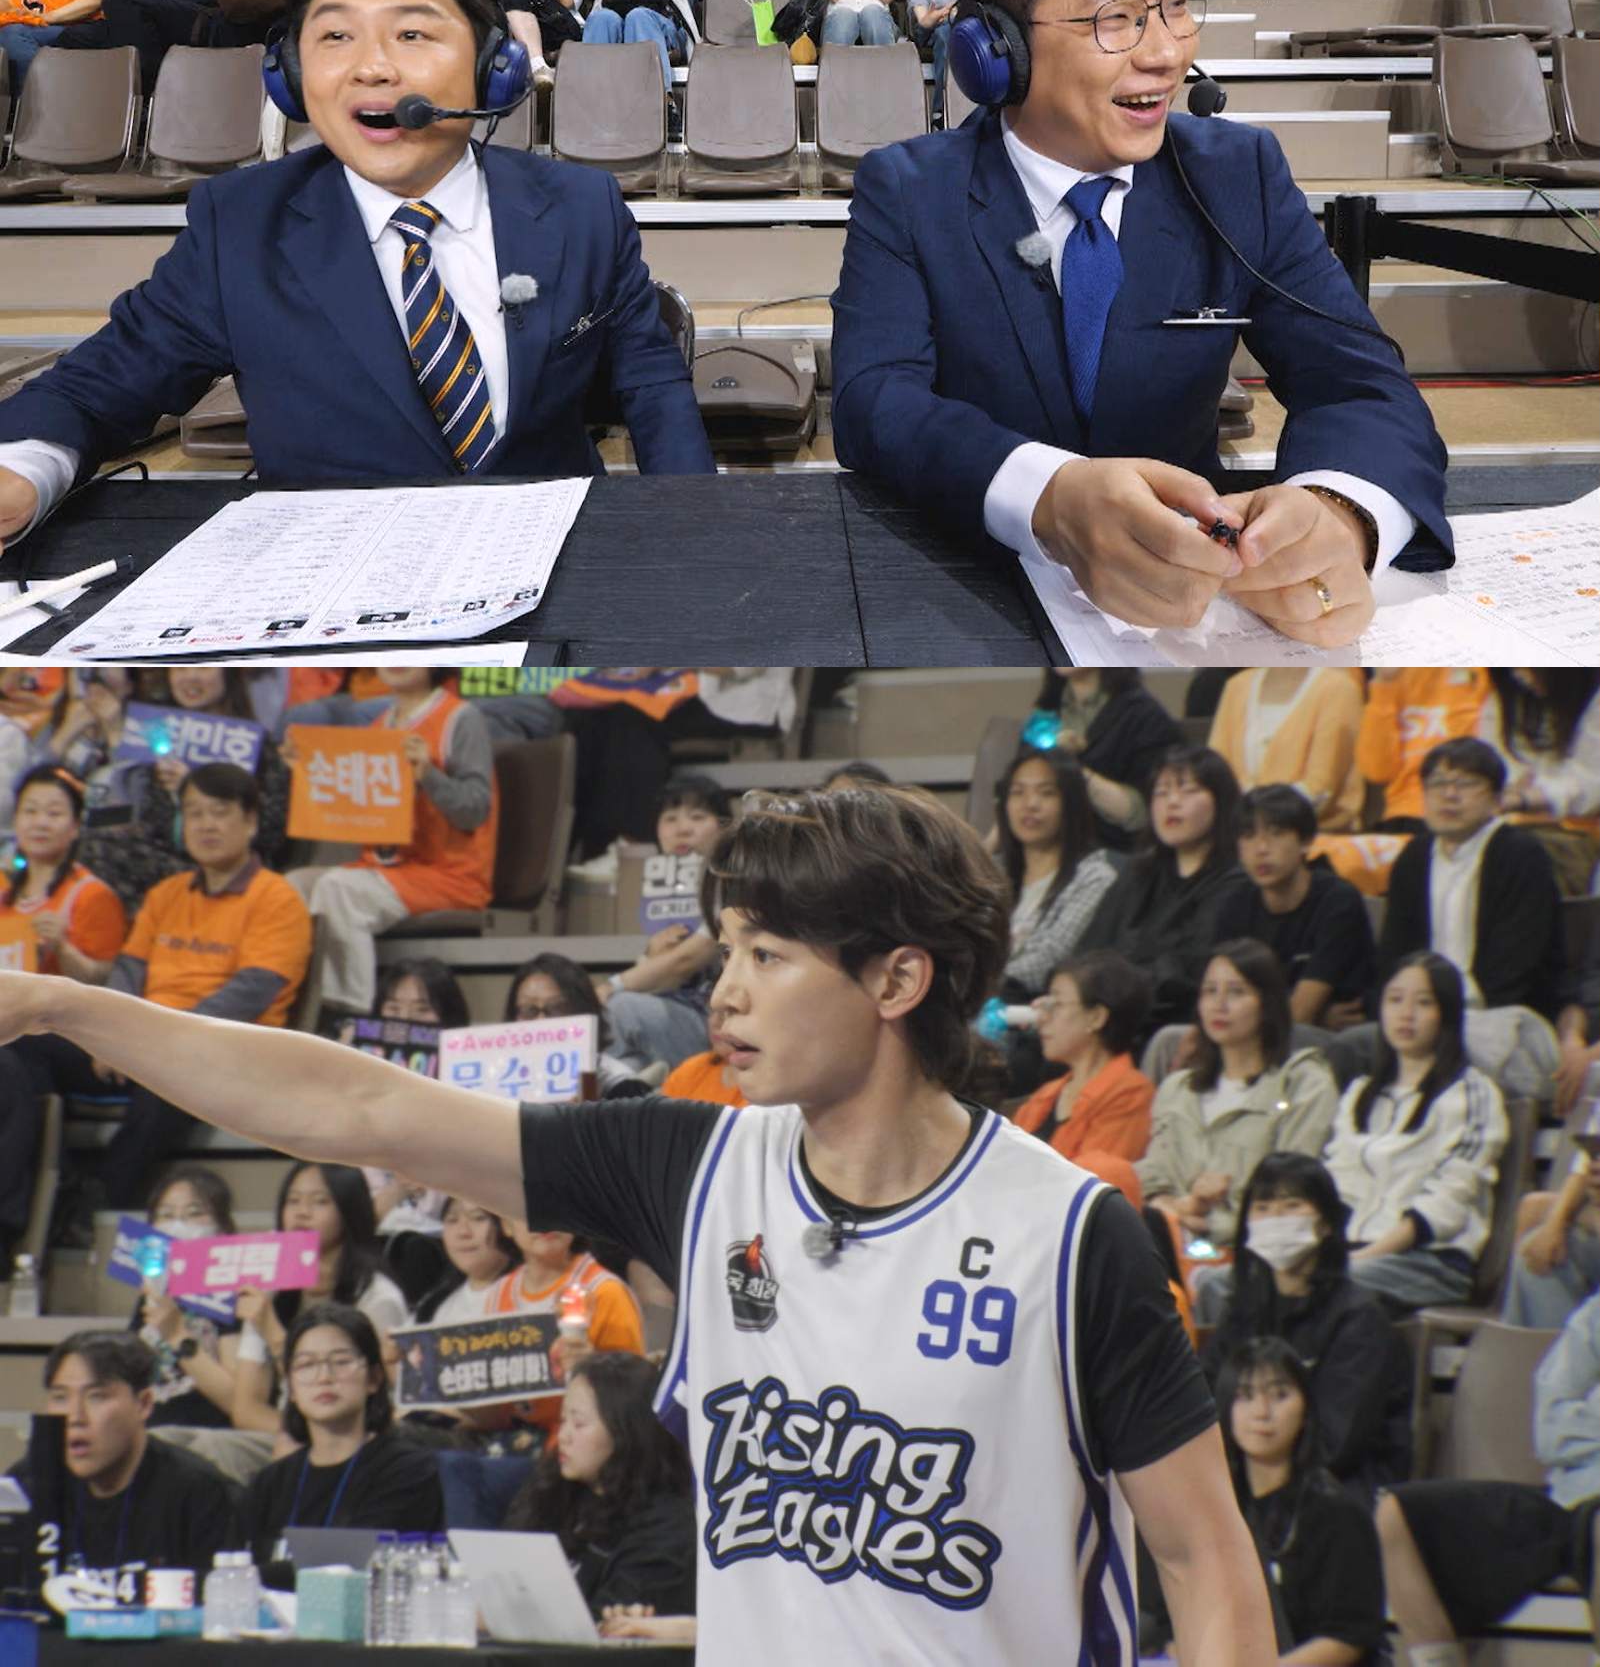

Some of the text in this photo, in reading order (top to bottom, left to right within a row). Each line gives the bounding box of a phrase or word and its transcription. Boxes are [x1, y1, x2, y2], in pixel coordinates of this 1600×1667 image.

[307, 751, 401, 807] 손태진
[463, 1030, 567, 1051] Awesome
[959, 1236, 995, 1280] C
[916, 1279, 1018, 1367] 99
[438, 1359, 489, 1396] 손태진
[709, 1470, 992, 1600] Eagles
